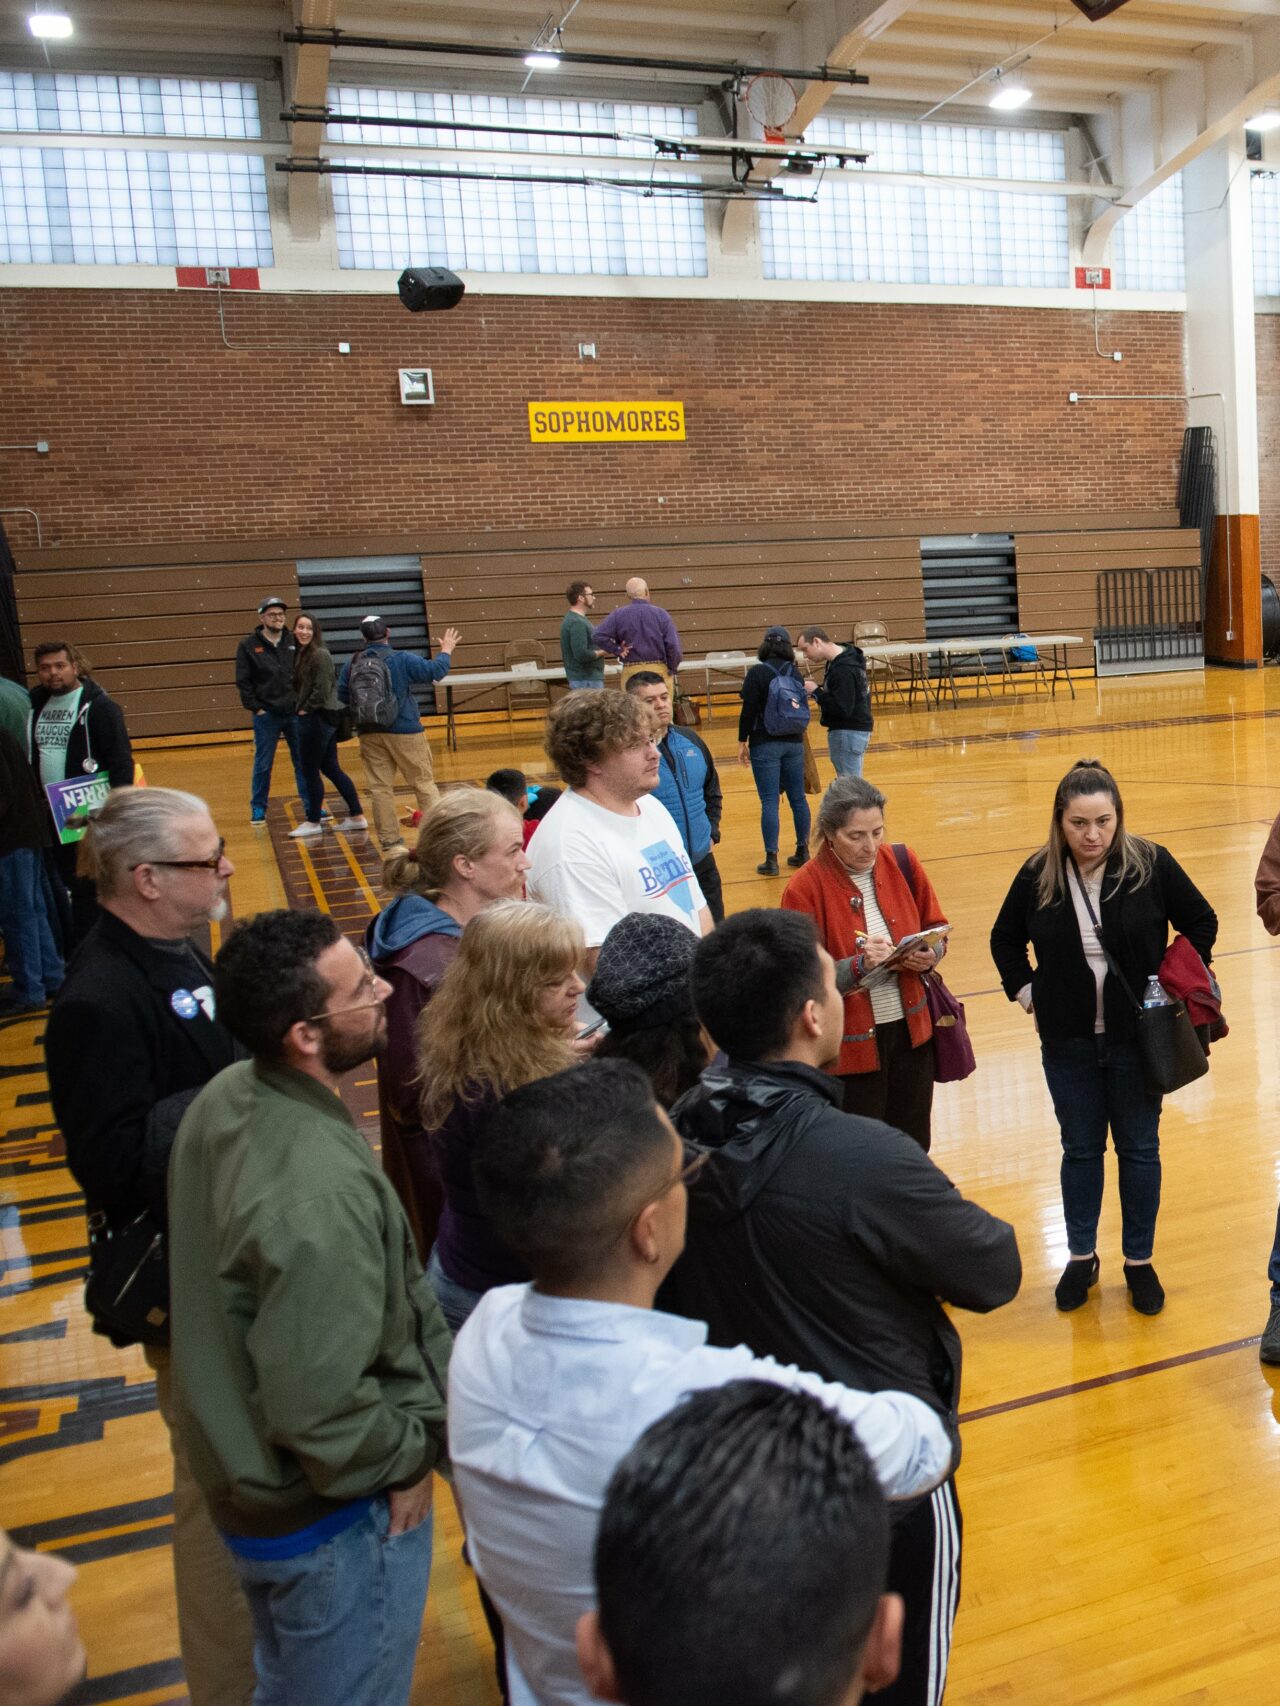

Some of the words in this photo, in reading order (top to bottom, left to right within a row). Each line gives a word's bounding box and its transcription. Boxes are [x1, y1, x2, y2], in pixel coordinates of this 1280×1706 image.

[534, 410, 681, 433] SOPHOMORES
[41, 709, 74, 721] WARREN
[639, 854, 692, 893] Bernie
